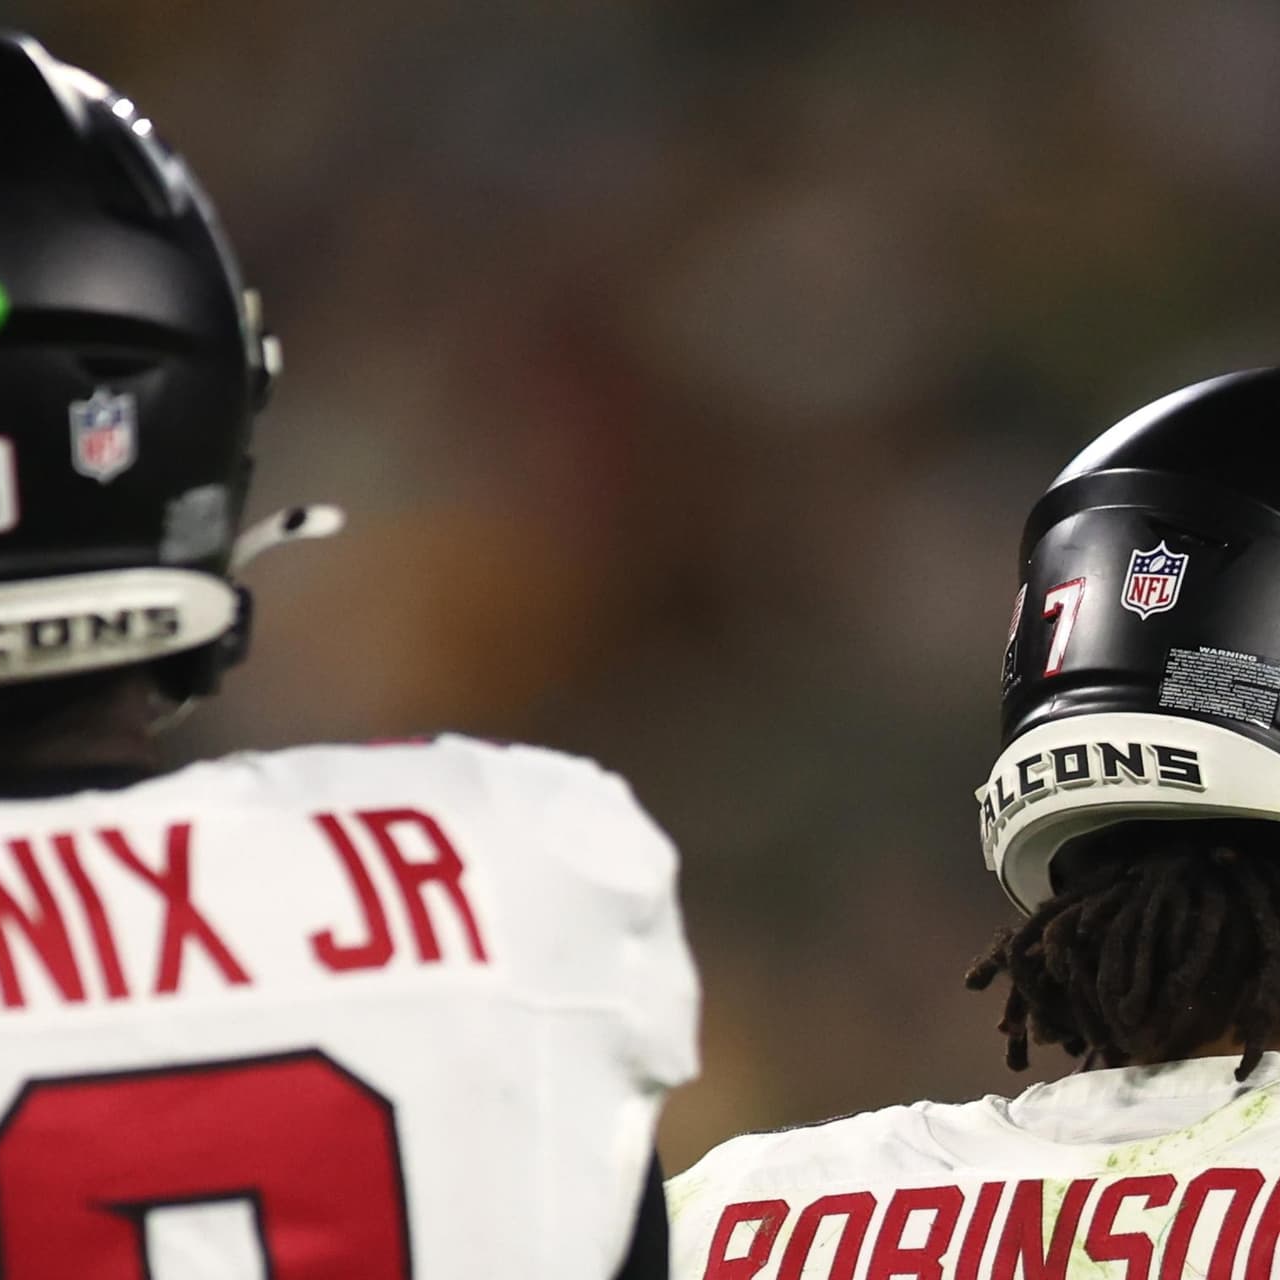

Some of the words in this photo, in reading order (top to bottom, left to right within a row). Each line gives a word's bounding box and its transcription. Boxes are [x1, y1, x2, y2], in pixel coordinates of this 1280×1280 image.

[1042, 576, 1087, 679] 7
[1129, 576, 1171, 606] NFL
[1199, 646, 1257, 663] WARNING
[978, 742, 1204, 836] ALCONS
[308, 807, 489, 973] JR
